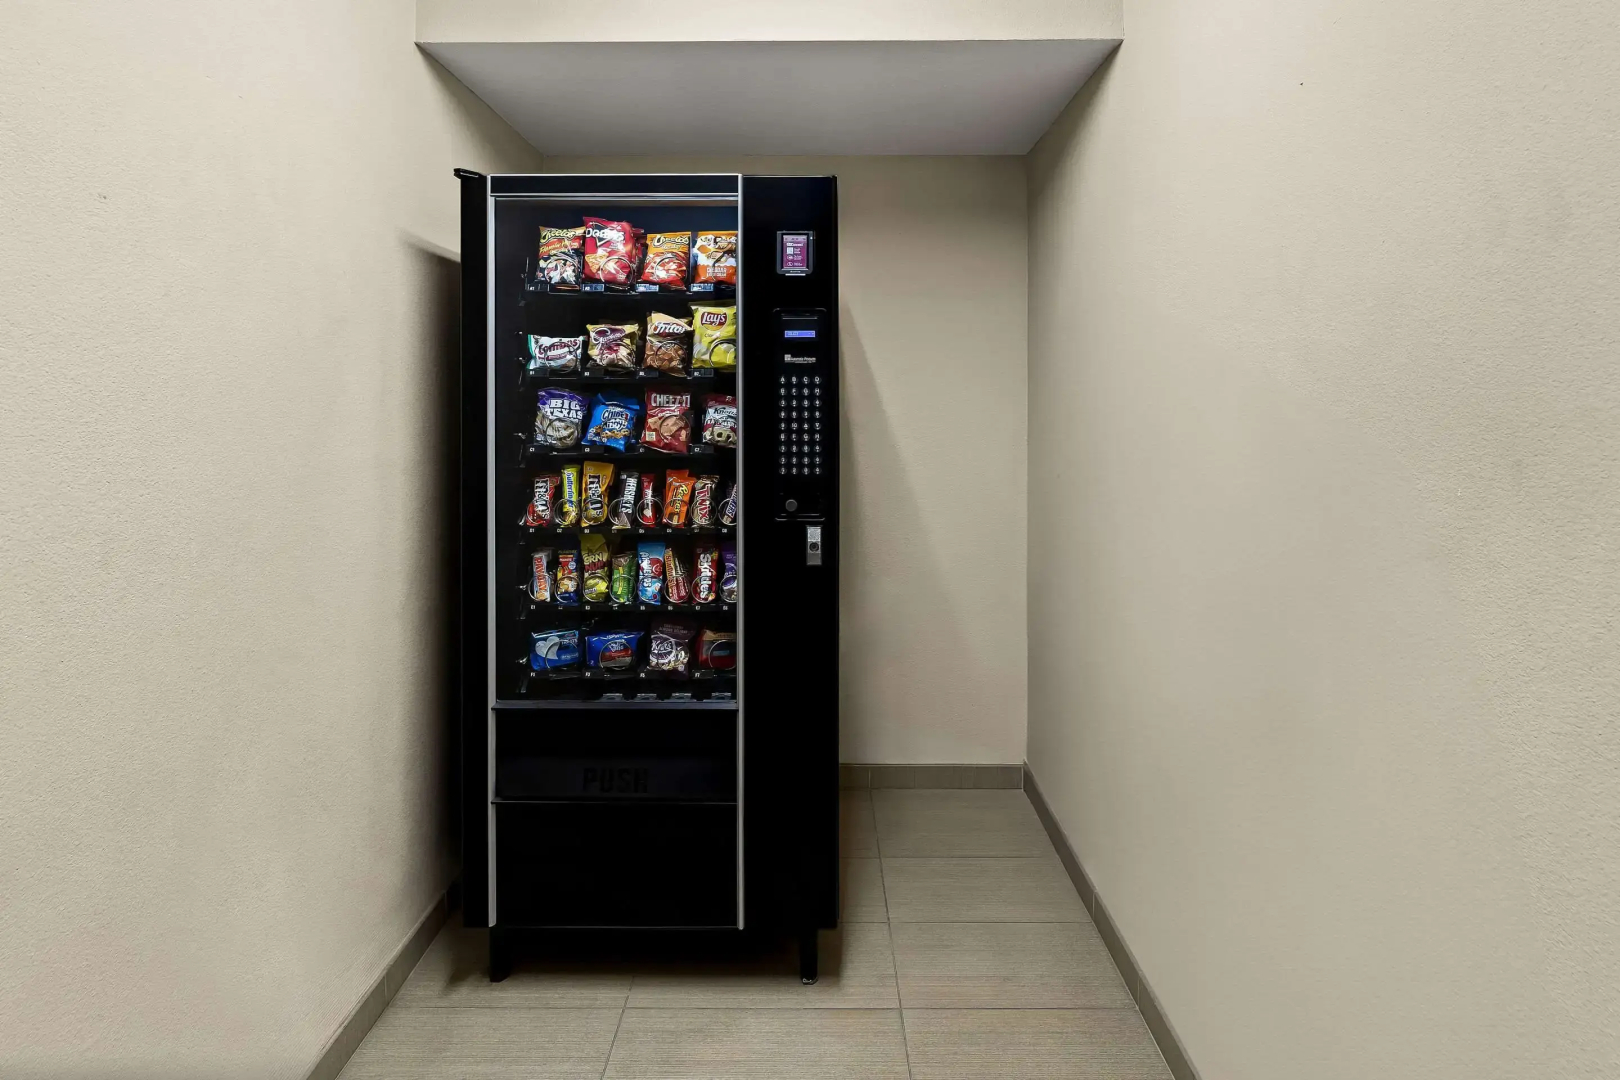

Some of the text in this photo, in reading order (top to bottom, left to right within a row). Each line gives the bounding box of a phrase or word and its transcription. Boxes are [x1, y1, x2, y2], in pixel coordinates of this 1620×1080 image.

[544, 408, 583, 420] TEXAS
[549, 398, 580, 410] BIG
[696, 485, 711, 520] TWIX
[700, 553, 712, 599] Skittles
[582, 768, 649, 794] PUSH
